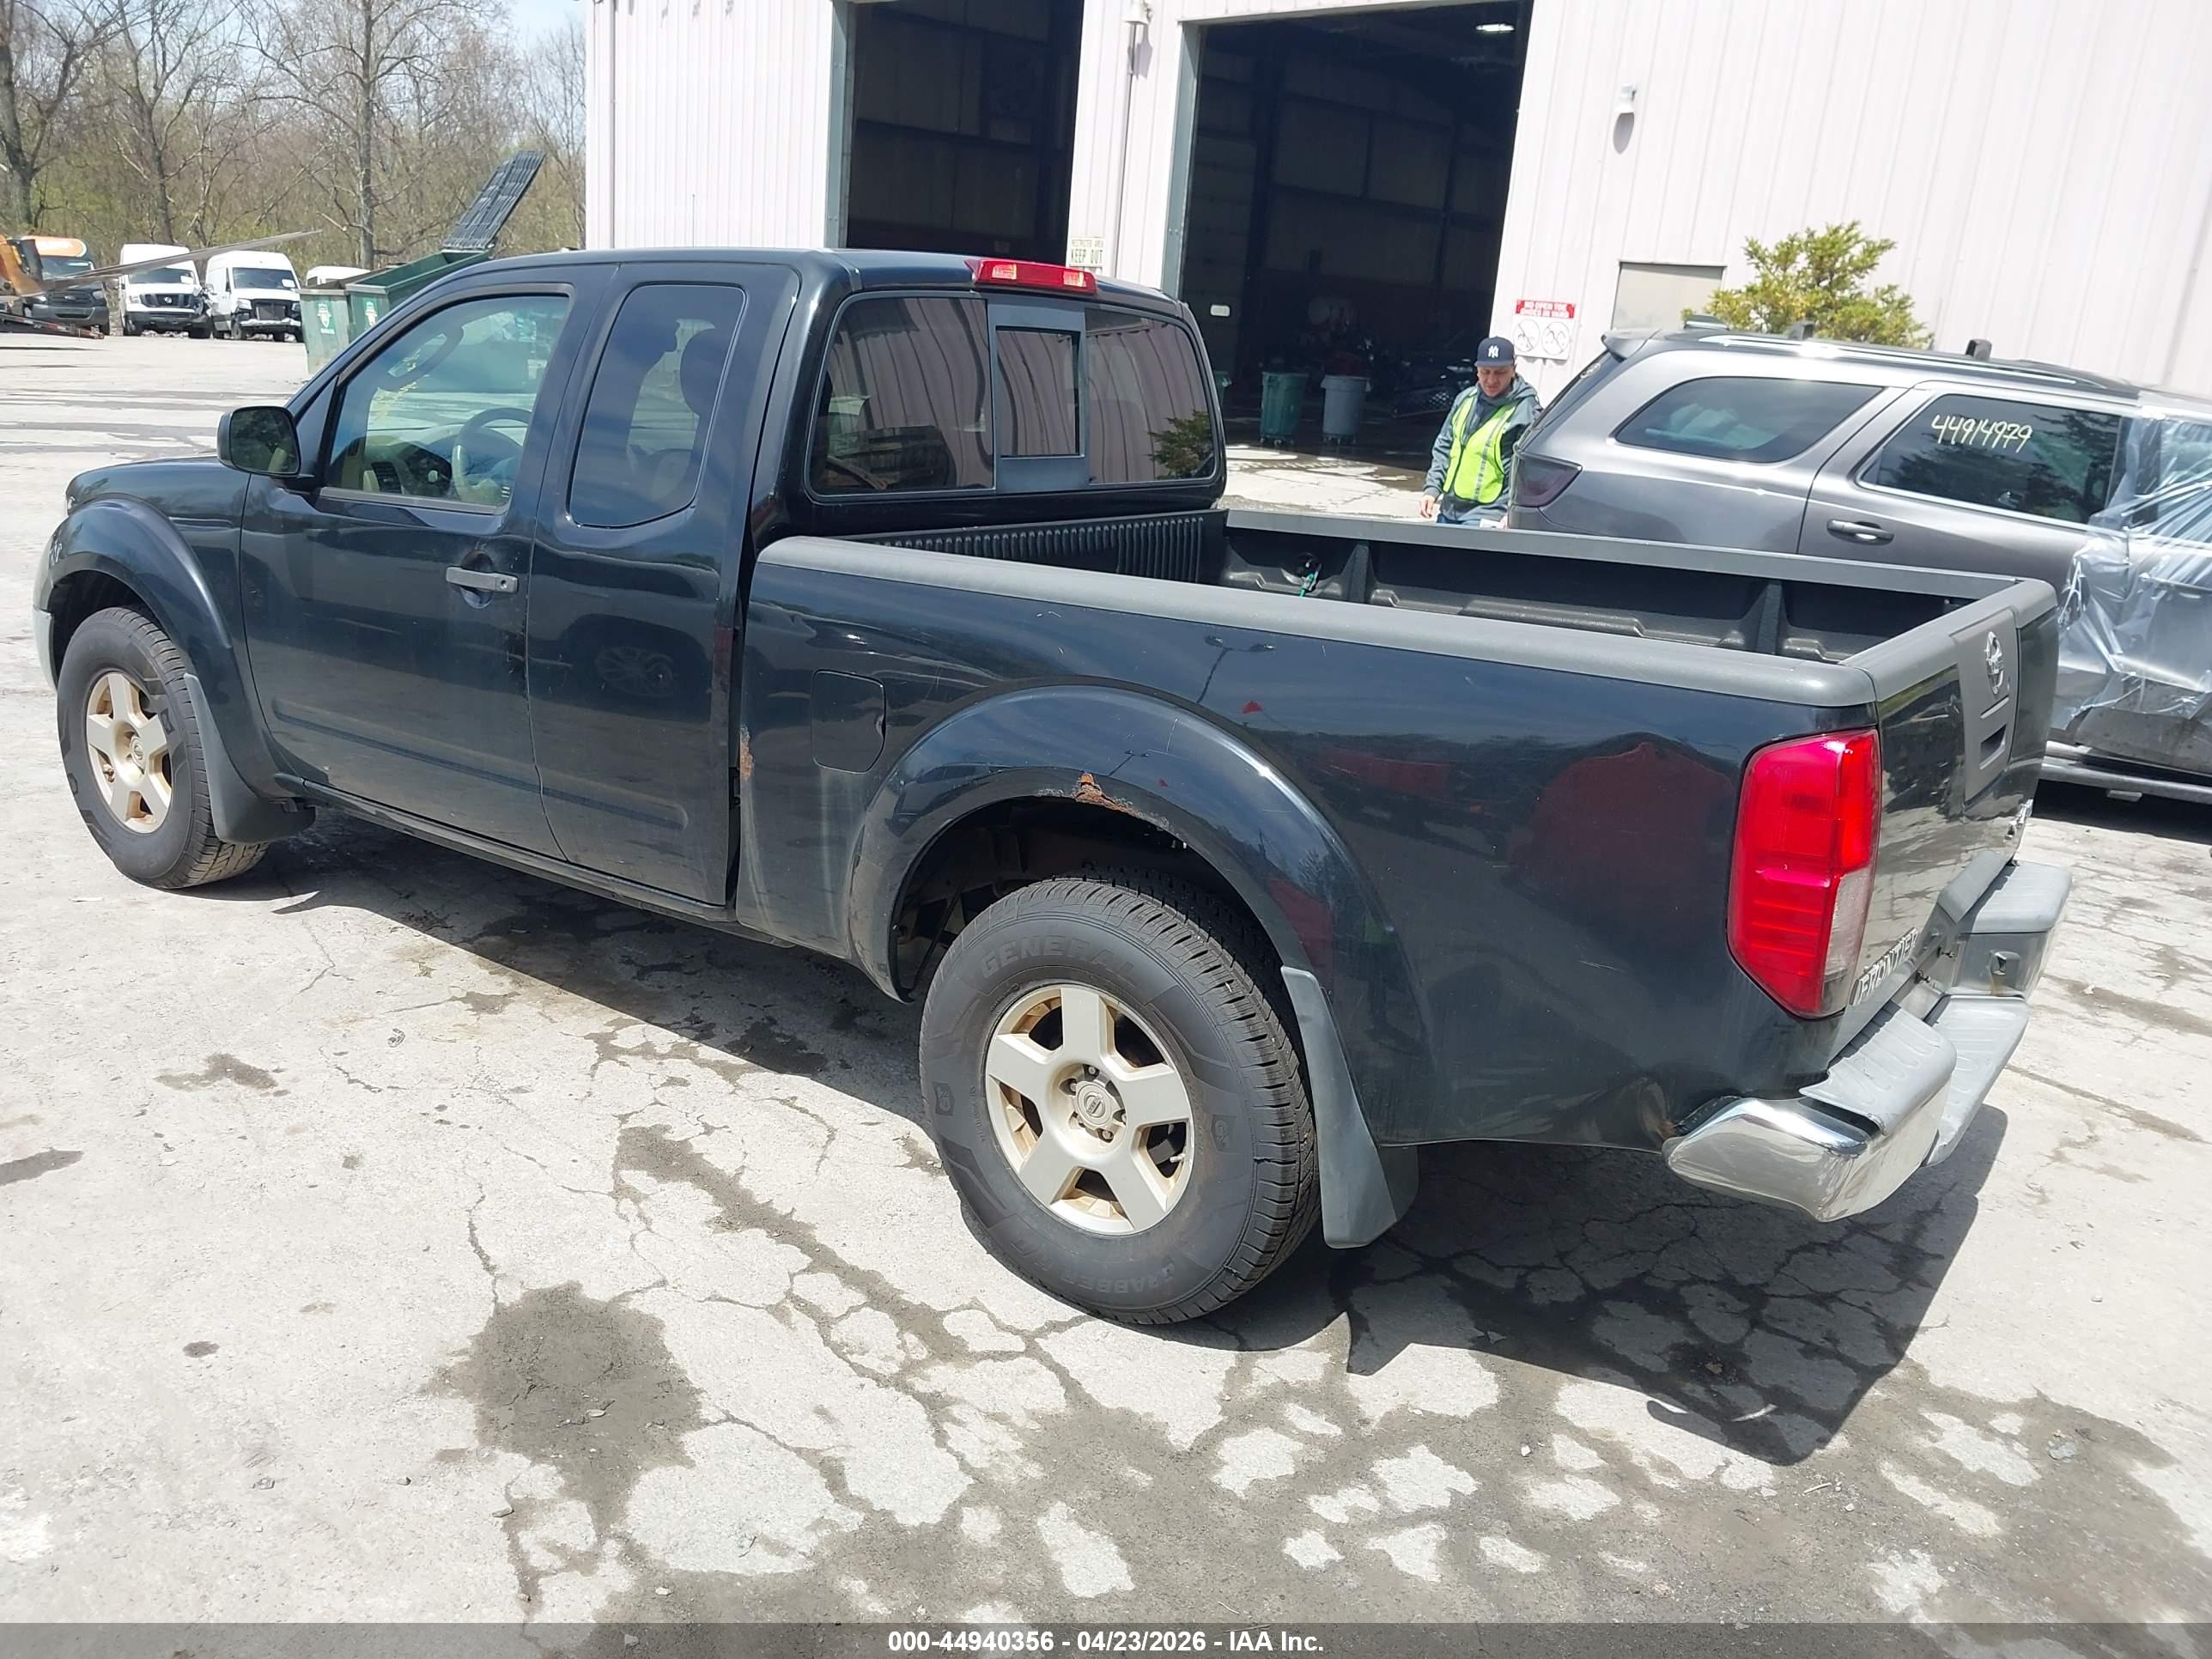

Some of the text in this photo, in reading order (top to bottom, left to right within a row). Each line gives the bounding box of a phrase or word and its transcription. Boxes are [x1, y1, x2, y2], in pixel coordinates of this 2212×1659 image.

[1071, 248, 1103, 264] KEEP OUT
[1931, 415, 2033, 453] 44914979
[981, 934, 1142, 989] GENERAL
[1851, 927, 1918, 1006] FRONTIER
